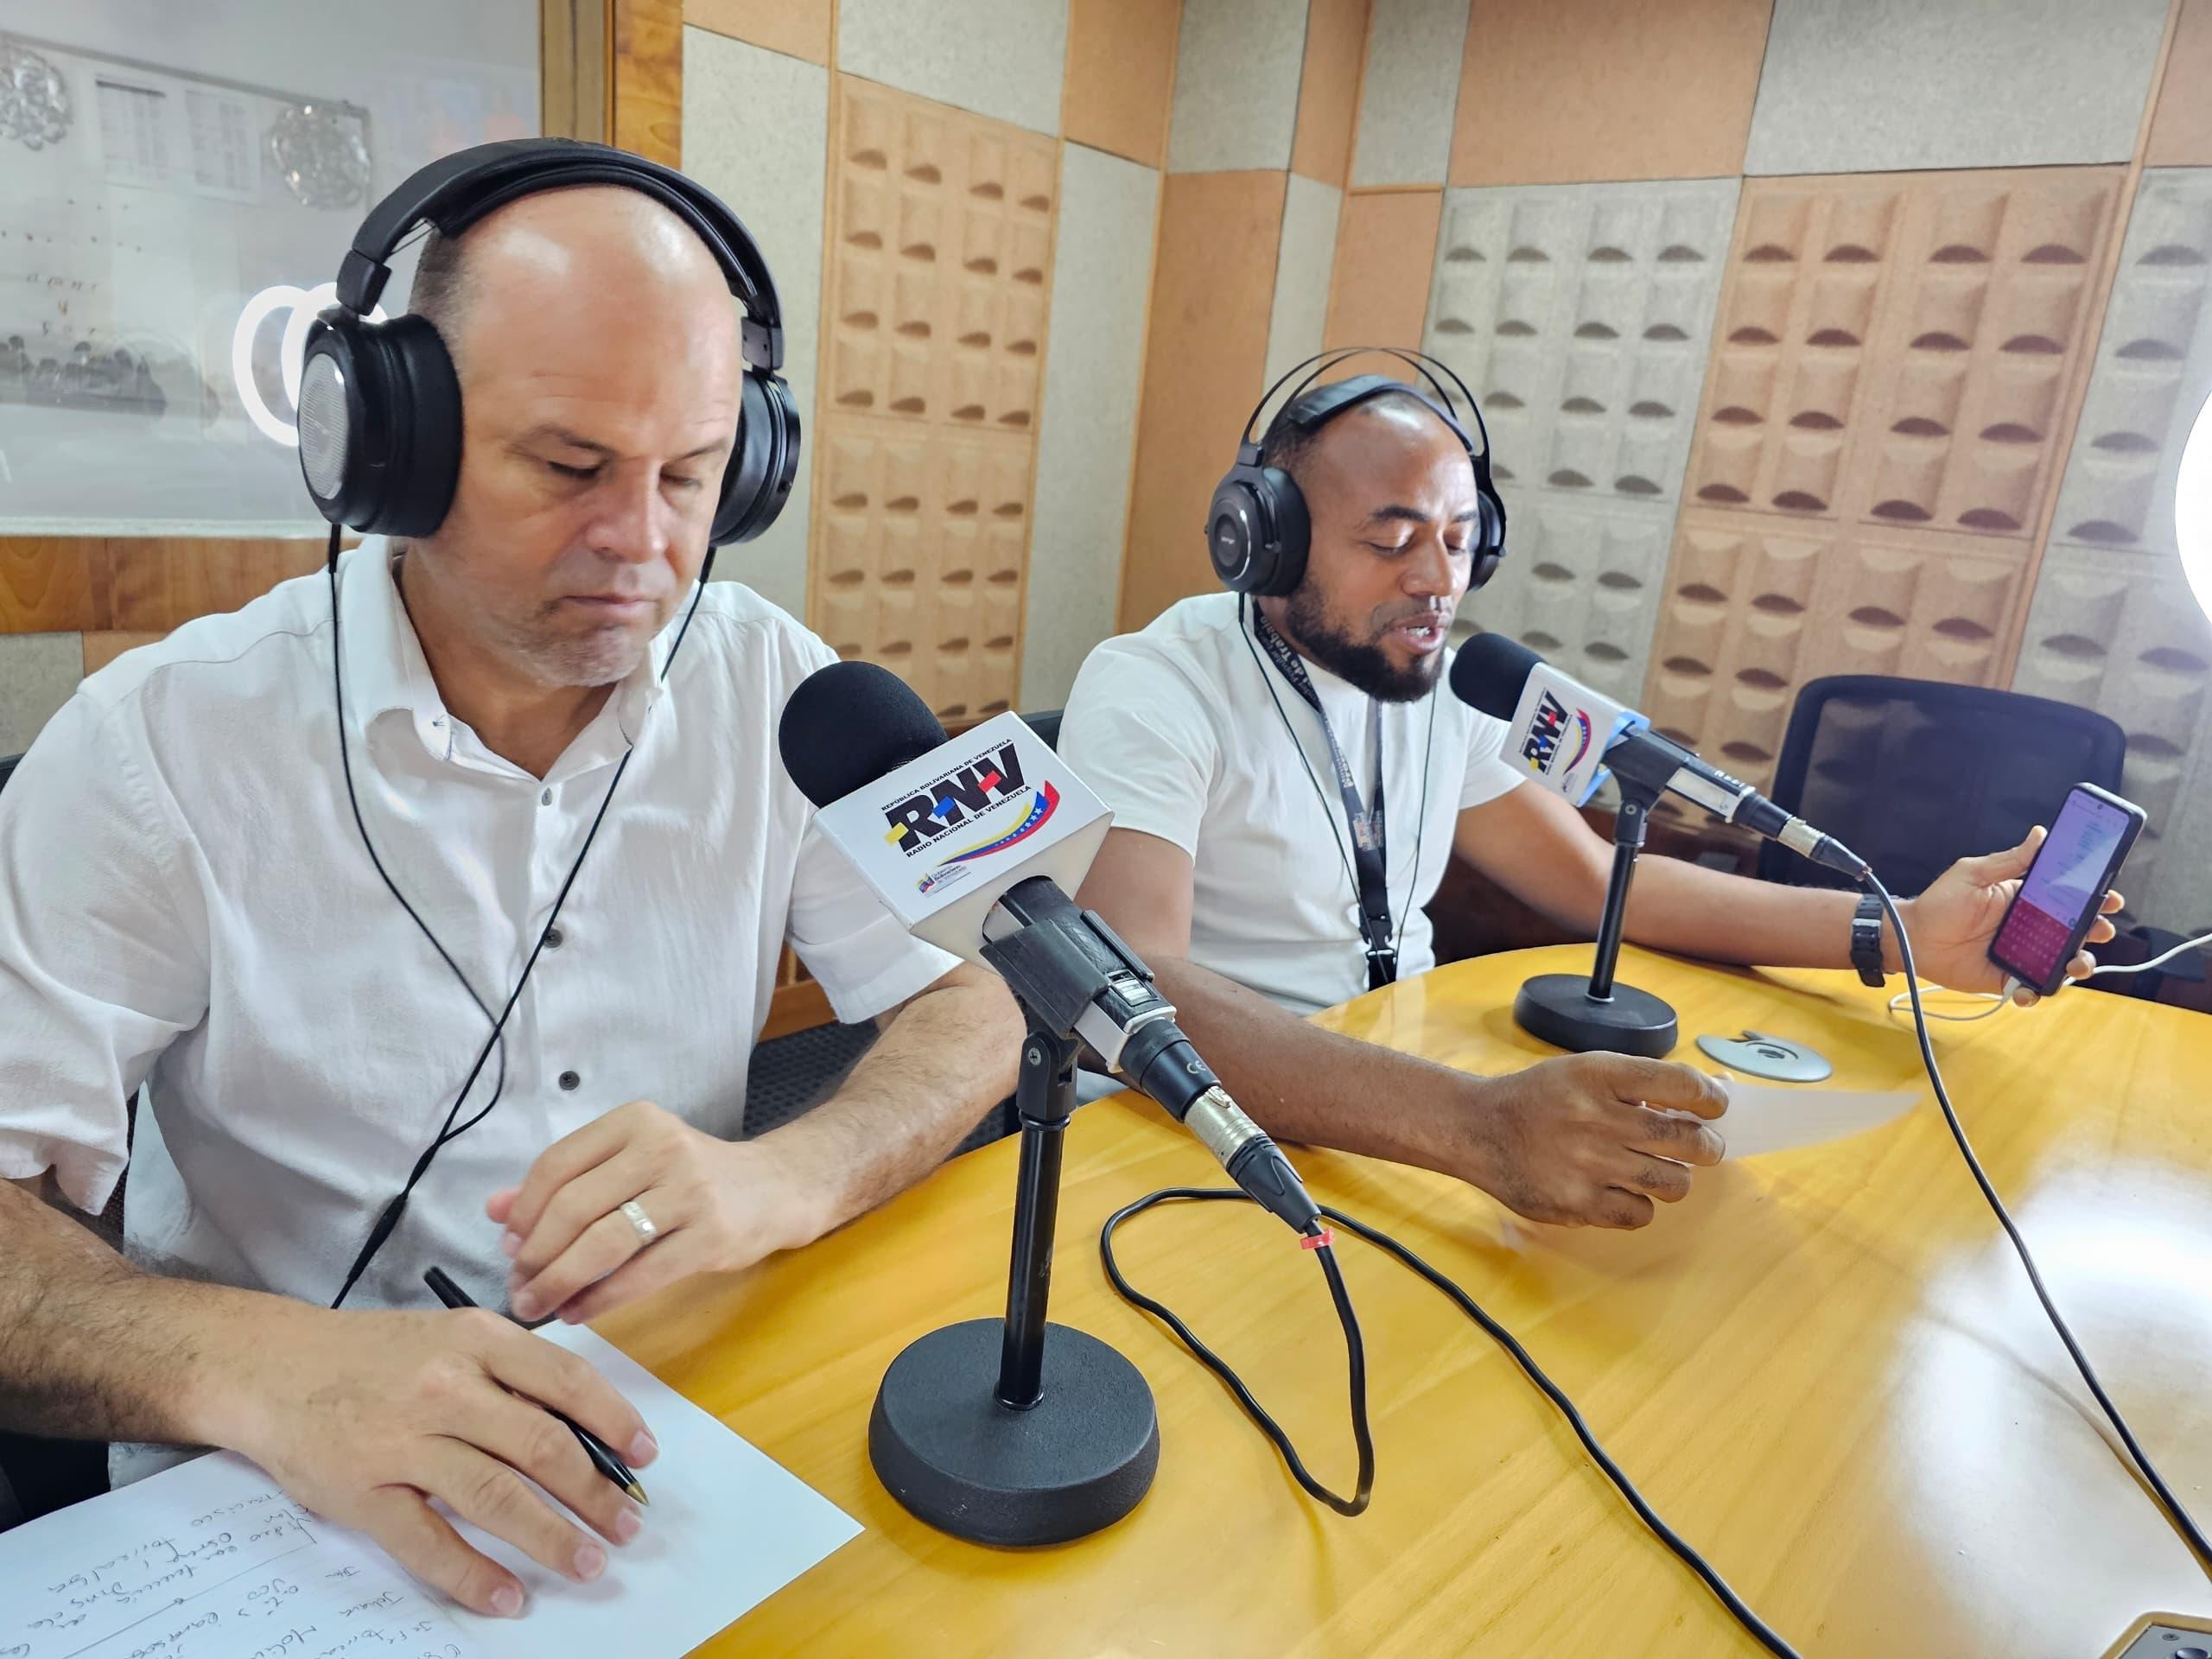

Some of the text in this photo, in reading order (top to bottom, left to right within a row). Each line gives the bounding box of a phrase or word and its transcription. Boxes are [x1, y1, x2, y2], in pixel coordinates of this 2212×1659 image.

[919, 766, 963, 790] BOLIVARIANA
[973, 739, 1012, 760] VENEZUELA
[1522, 690, 1568, 772] RNV
[884, 742, 1025, 853] RNV
[906, 785, 1032, 858] RADIO NACIONAL DE VENEZUELA
[1186, 1059, 1206, 1074] CE
